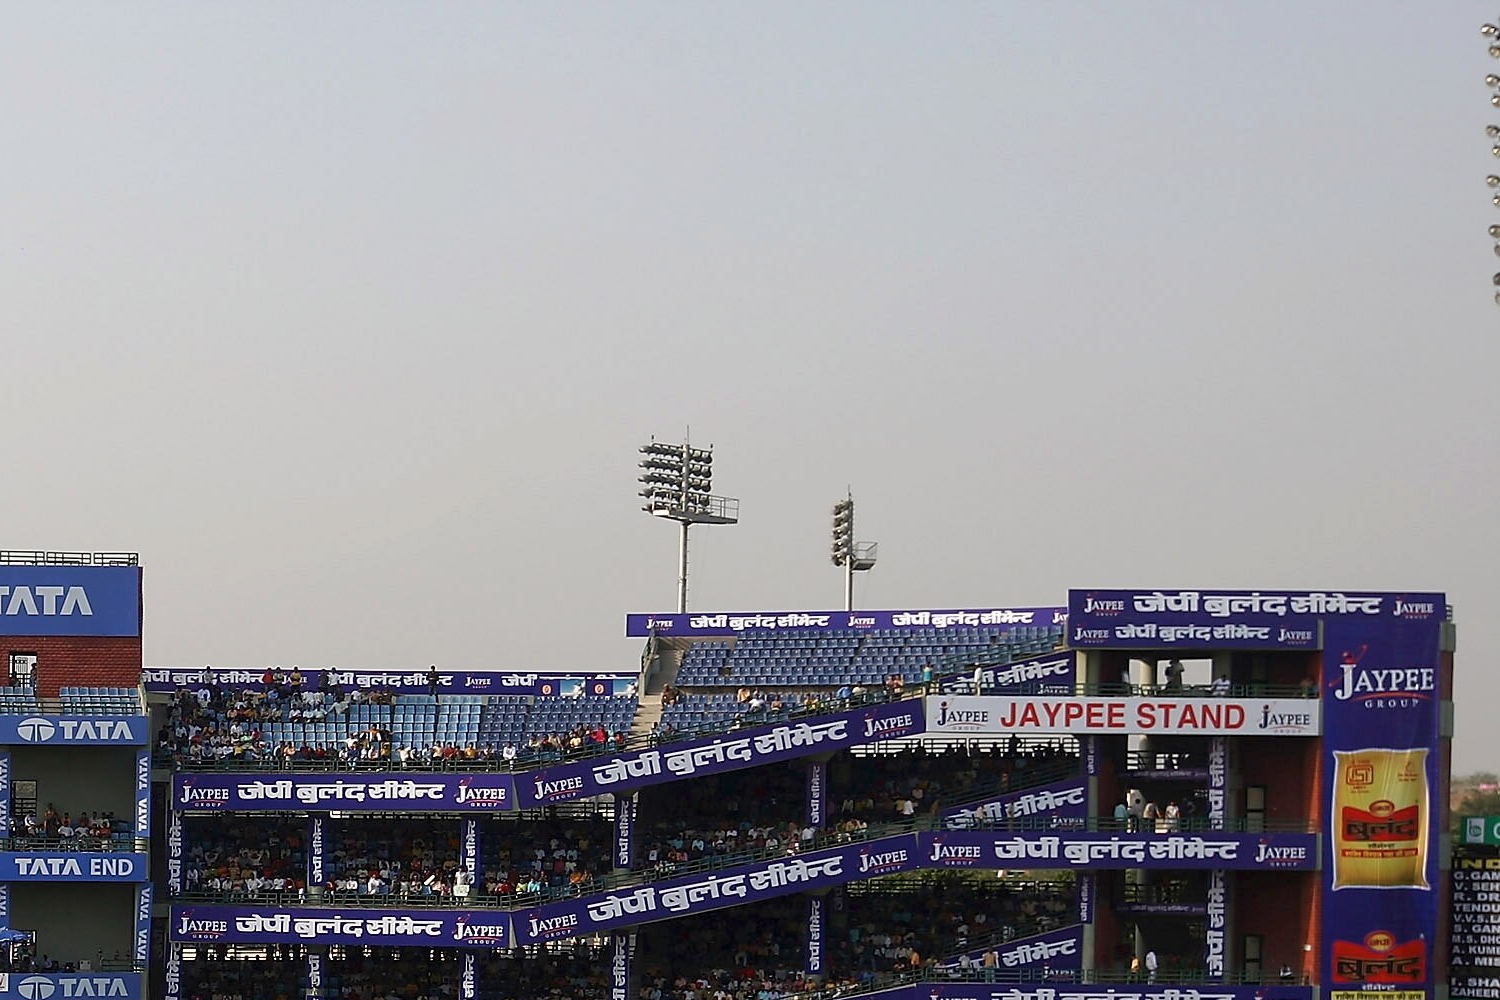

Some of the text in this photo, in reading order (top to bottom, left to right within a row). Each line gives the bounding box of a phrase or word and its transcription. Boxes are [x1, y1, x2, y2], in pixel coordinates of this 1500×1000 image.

[1083, 597, 1125, 613] JAYPEE
[1392, 600, 1434, 616] JAYPEE
[1278, 628, 1312, 642] JAYPEE
[1335, 664, 1434, 700] JAYPEE
[937, 706, 988, 726] JAYPEE
[1000, 702, 1246, 729] JAYPEE STAND
[1259, 704, 1310, 730] JAYPEE
[59, 720, 134, 741] TATA
[864, 714, 912, 738] JAYPEE
[139, 756, 148, 790] TATA
[180, 785, 229, 802] JAYPEE
[456, 784, 506, 803] JAYPEE
[534, 776, 583, 800] JAYPEE
[859, 850, 908, 872] JAYPEE
[930, 842, 981, 861] JAYPEE
[1255, 844, 1306, 863] JAYPEE
[15, 858, 134, 876] TATA END
[178, 916, 228, 934] JAYPEE
[454, 920, 504, 940] JAYPEE
[529, 912, 578, 937] JAYPEE
[59, 978, 128, 998] TATA
